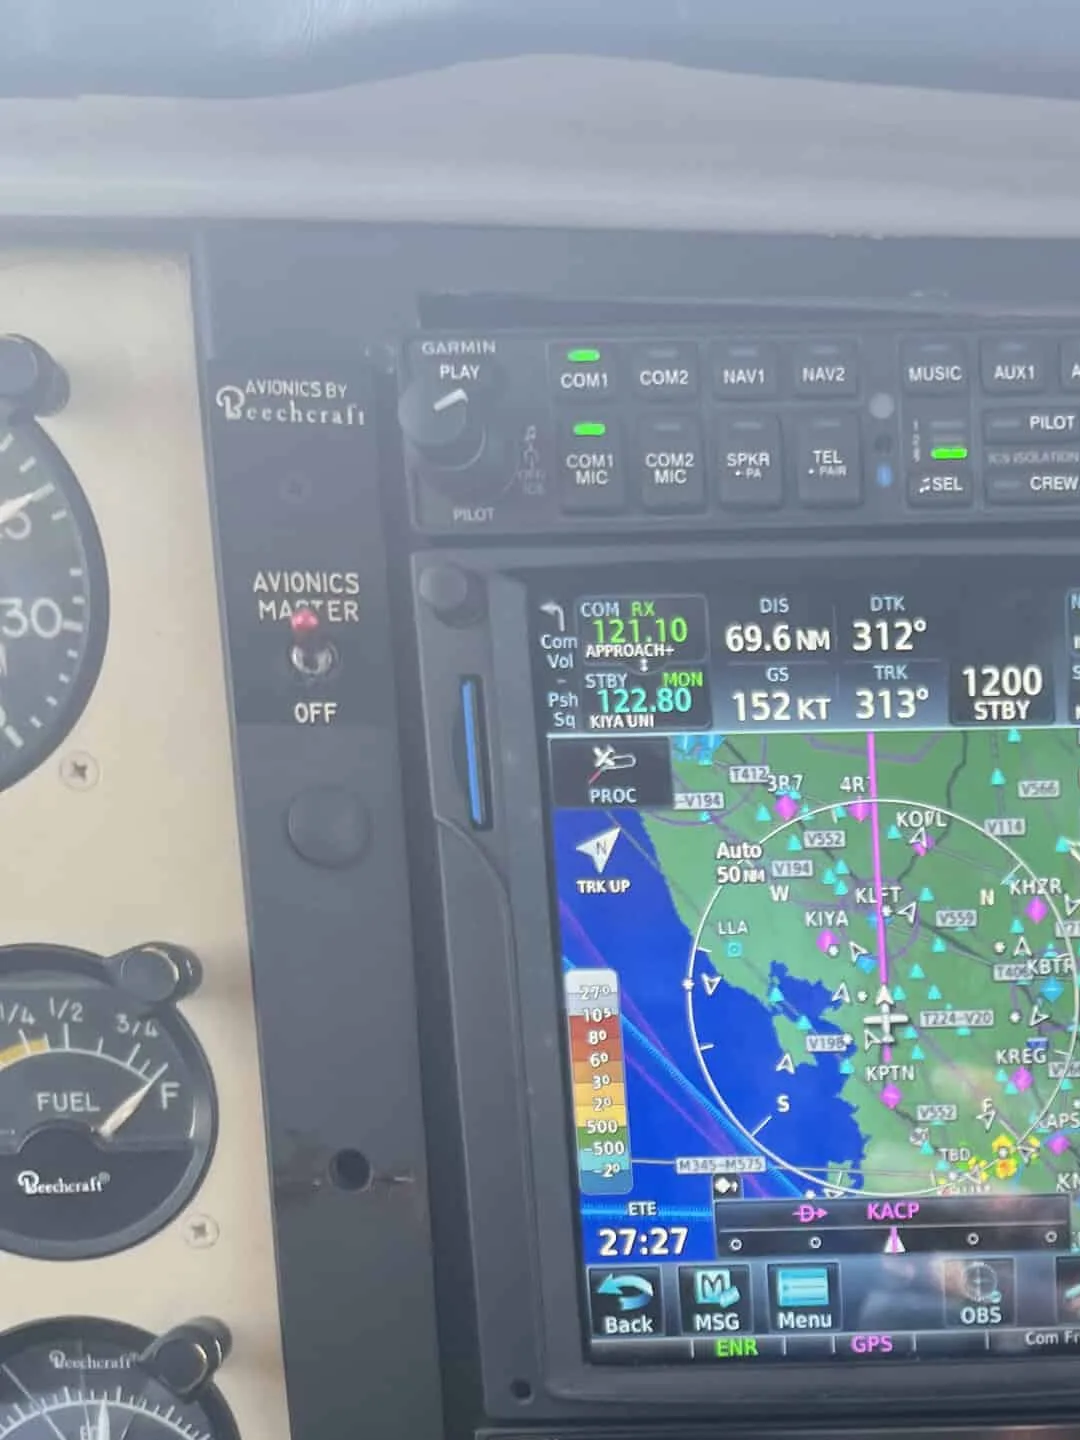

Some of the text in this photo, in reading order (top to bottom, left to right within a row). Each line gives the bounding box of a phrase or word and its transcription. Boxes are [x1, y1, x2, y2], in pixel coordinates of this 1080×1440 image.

[421, 341, 497, 355] GARMIN
[439, 364, 480, 380] PLAY
[560, 372, 609, 389] COM1
[639, 369, 689, 386] COM2
[723, 368, 766, 385] NAV1
[802, 366, 846, 383] NAV2
[908, 366, 962, 382] MUSIC
[993, 364, 1036, 380] AUX1
[245, 379, 348, 400] AVIONICS BY
[216, 385, 366, 426] Beechcraft
[1029, 415, 1075, 431] PILOT
[566, 453, 615, 469] COM1
[645, 452, 695, 468] COM2
[726, 452, 770, 467] SPKR
[812, 449, 843, 465] TEL
[1012, 450, 1080, 464] ISOLATION
[575, 469, 609, 486] MIC
[654, 468, 687, 485] MIC
[746, 468, 762, 480] PA
[819, 465, 847, 478] PAIR
[932, 475, 963, 491] SEL
[1029, 475, 1079, 491] CREW
[452, 506, 495, 522] PILOT
[252, 570, 361, 595] AVIONICS
[580, 601, 655, 618] COM RX
[758, 597, 790, 614] DIS
[869, 595, 906, 612] DTK
[0, 596, 63, 639] 30
[593, 617, 689, 645] 121.10
[725, 622, 831, 653] 69.6 NM
[540, 634, 578, 650] Com
[584, 643, 675, 659] APPROACH+
[546, 654, 574, 670] Vol
[584, 671, 704, 689] STBY MON
[765, 666, 790, 683] GS
[872, 664, 909, 681] TRK
[961, 664, 1043, 698] 1200
[547, 692, 579, 708] Psh
[597, 687, 692, 714] 122.80
[731, 690, 832, 722] 152 KT
[293, 701, 338, 724] OFF
[973, 700, 1031, 721] STBY
[553, 712, 576, 731] Sq
[589, 714, 655, 729] KIYA UNI
[589, 788, 637, 803] PROC
[715, 842, 762, 860] Auto
[716, 866, 740, 884] 50
[575, 879, 632, 894] TRK UP
[769, 885, 790, 902] W
[979, 889, 995, 905] N
[716, 920, 749, 935] LLA
[804, 910, 849, 928] KIYA
[49, 996, 85, 1022] 1/2
[115, 1014, 160, 1038] 3/4
[996, 1048, 1047, 1064] KREG
[865, 1065, 915, 1082] KPTN
[36, 1091, 101, 1113] FUEL
[160, 1081, 181, 1111] F
[775, 1095, 791, 1113] S
[586, 1119, 618, 1134] 500
[627, 1202, 658, 1217] ETE
[866, 1202, 921, 1221] KACP
[597, 1226, 689, 1257] 27:27
[695, 1312, 740, 1331] MSG
[777, 1311, 833, 1330] Menu
[959, 1306, 1003, 1325] OBS
[604, 1316, 654, 1334] Back
[851, 1335, 894, 1354] GPS
[1025, 1330, 1060, 1346] Com
[715, 1338, 760, 1357] ENR
